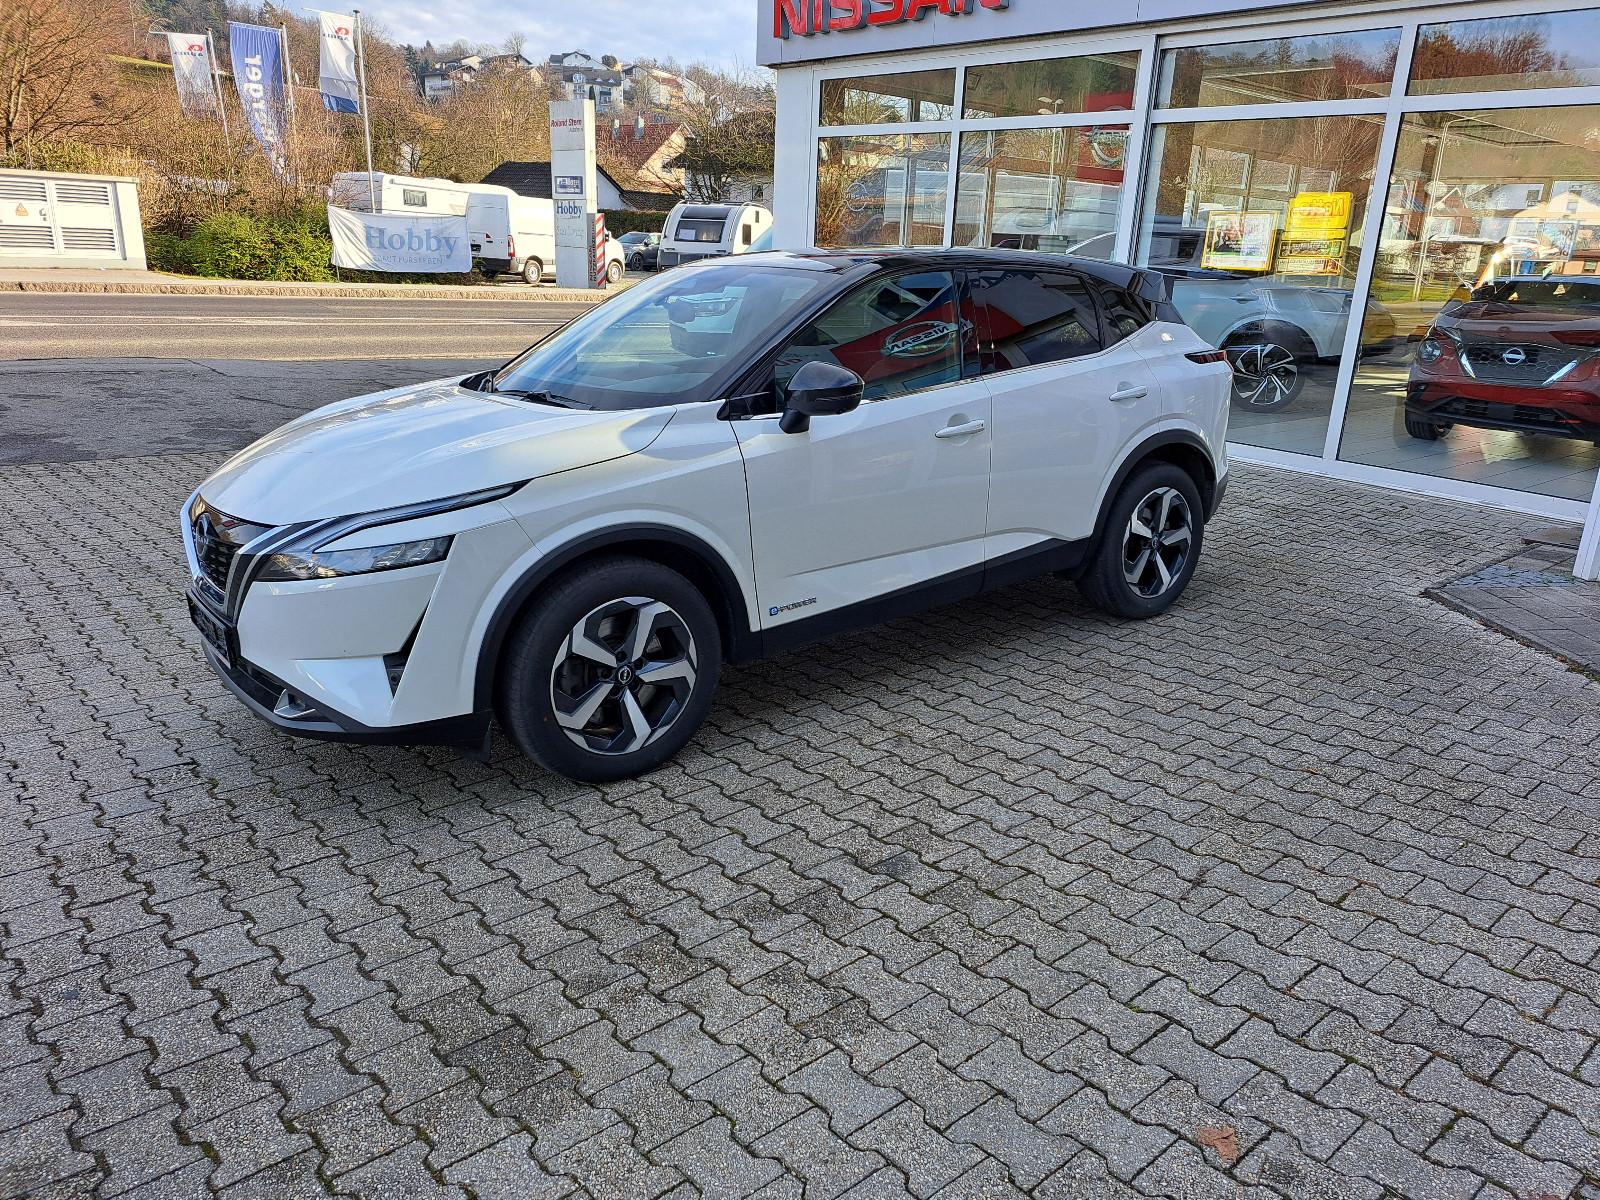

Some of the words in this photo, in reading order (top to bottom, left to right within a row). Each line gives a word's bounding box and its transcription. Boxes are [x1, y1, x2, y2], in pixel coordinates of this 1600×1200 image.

[773, 0, 1007, 38] NISS
[556, 200, 583, 216] Hobby
[364, 223, 460, 258] Hobby
